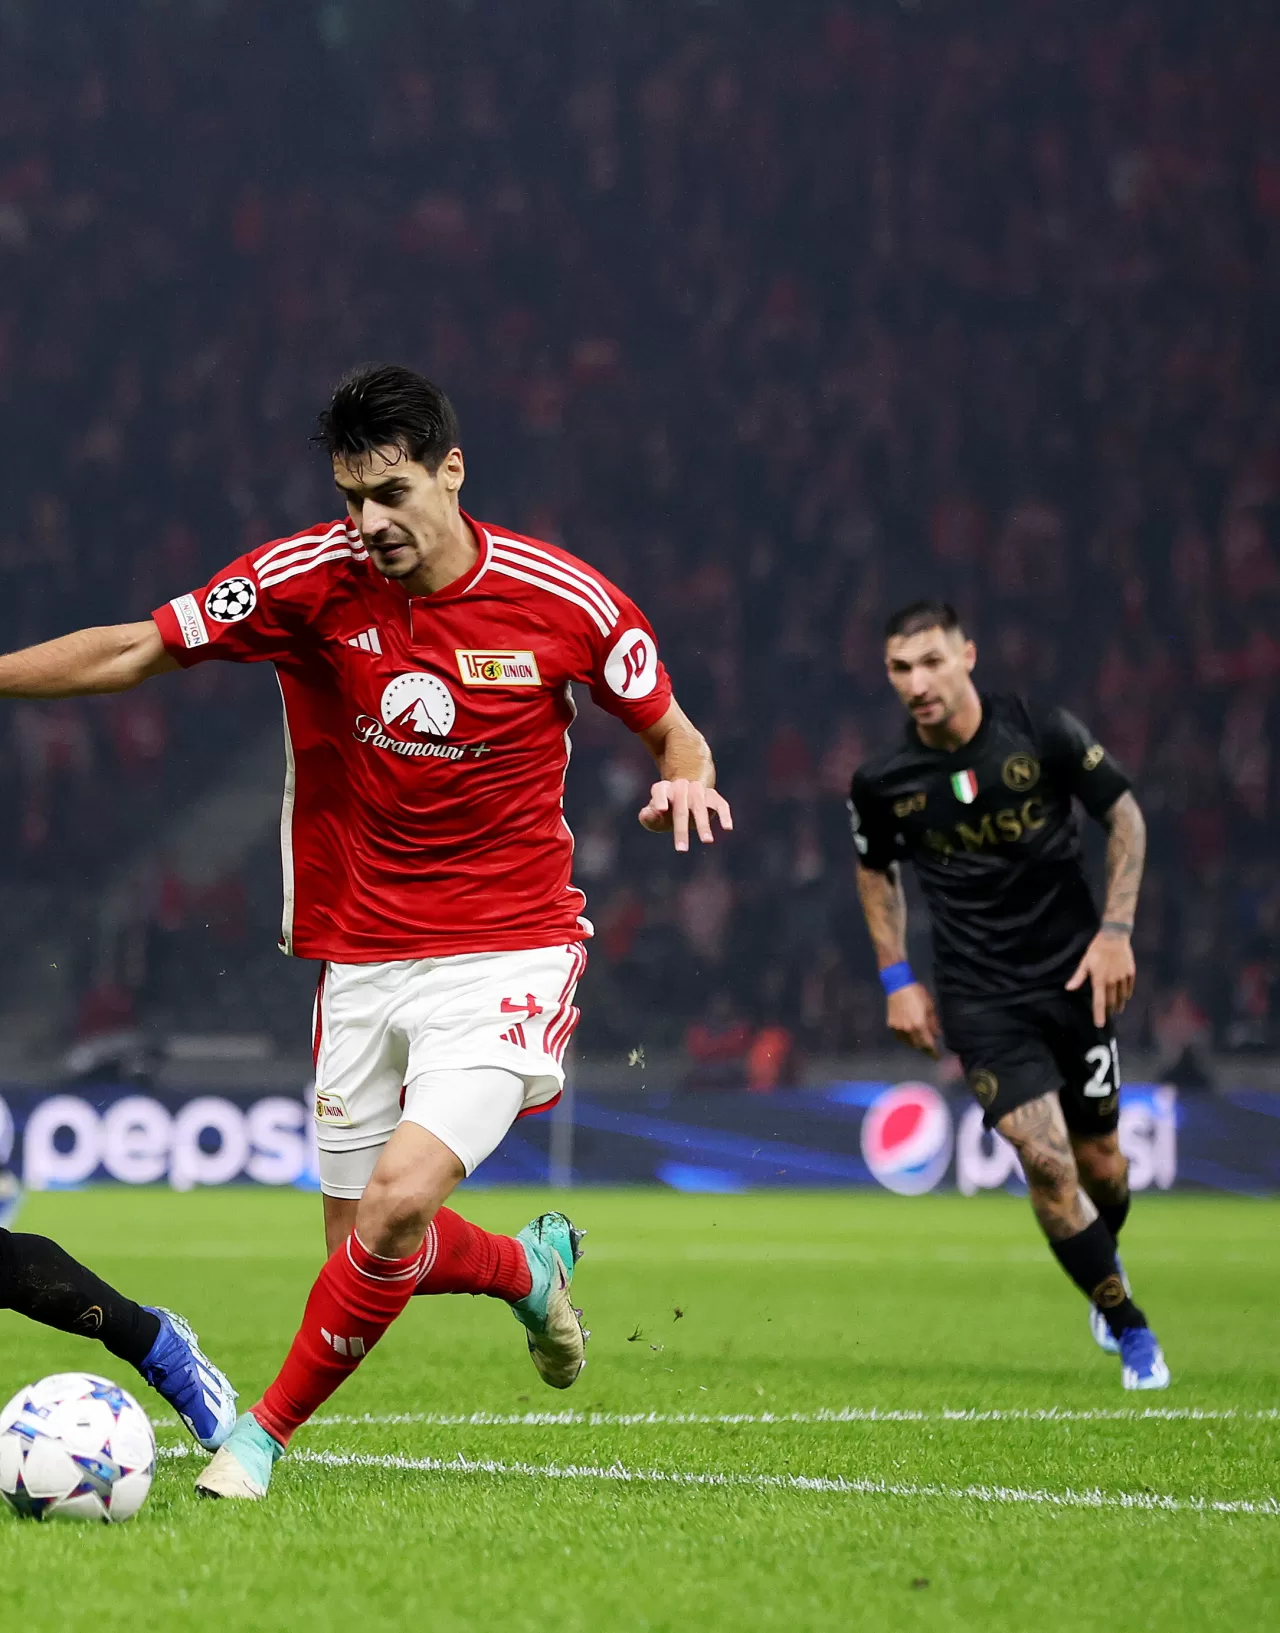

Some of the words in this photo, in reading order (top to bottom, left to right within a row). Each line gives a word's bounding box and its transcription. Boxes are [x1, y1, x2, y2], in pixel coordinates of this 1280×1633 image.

[503, 664, 533, 678] UNION
[622, 639, 647, 693] JD
[955, 797, 1046, 848] MSC
[500, 992, 543, 1018] 4
[1083, 1038, 1120, 1098] 21
